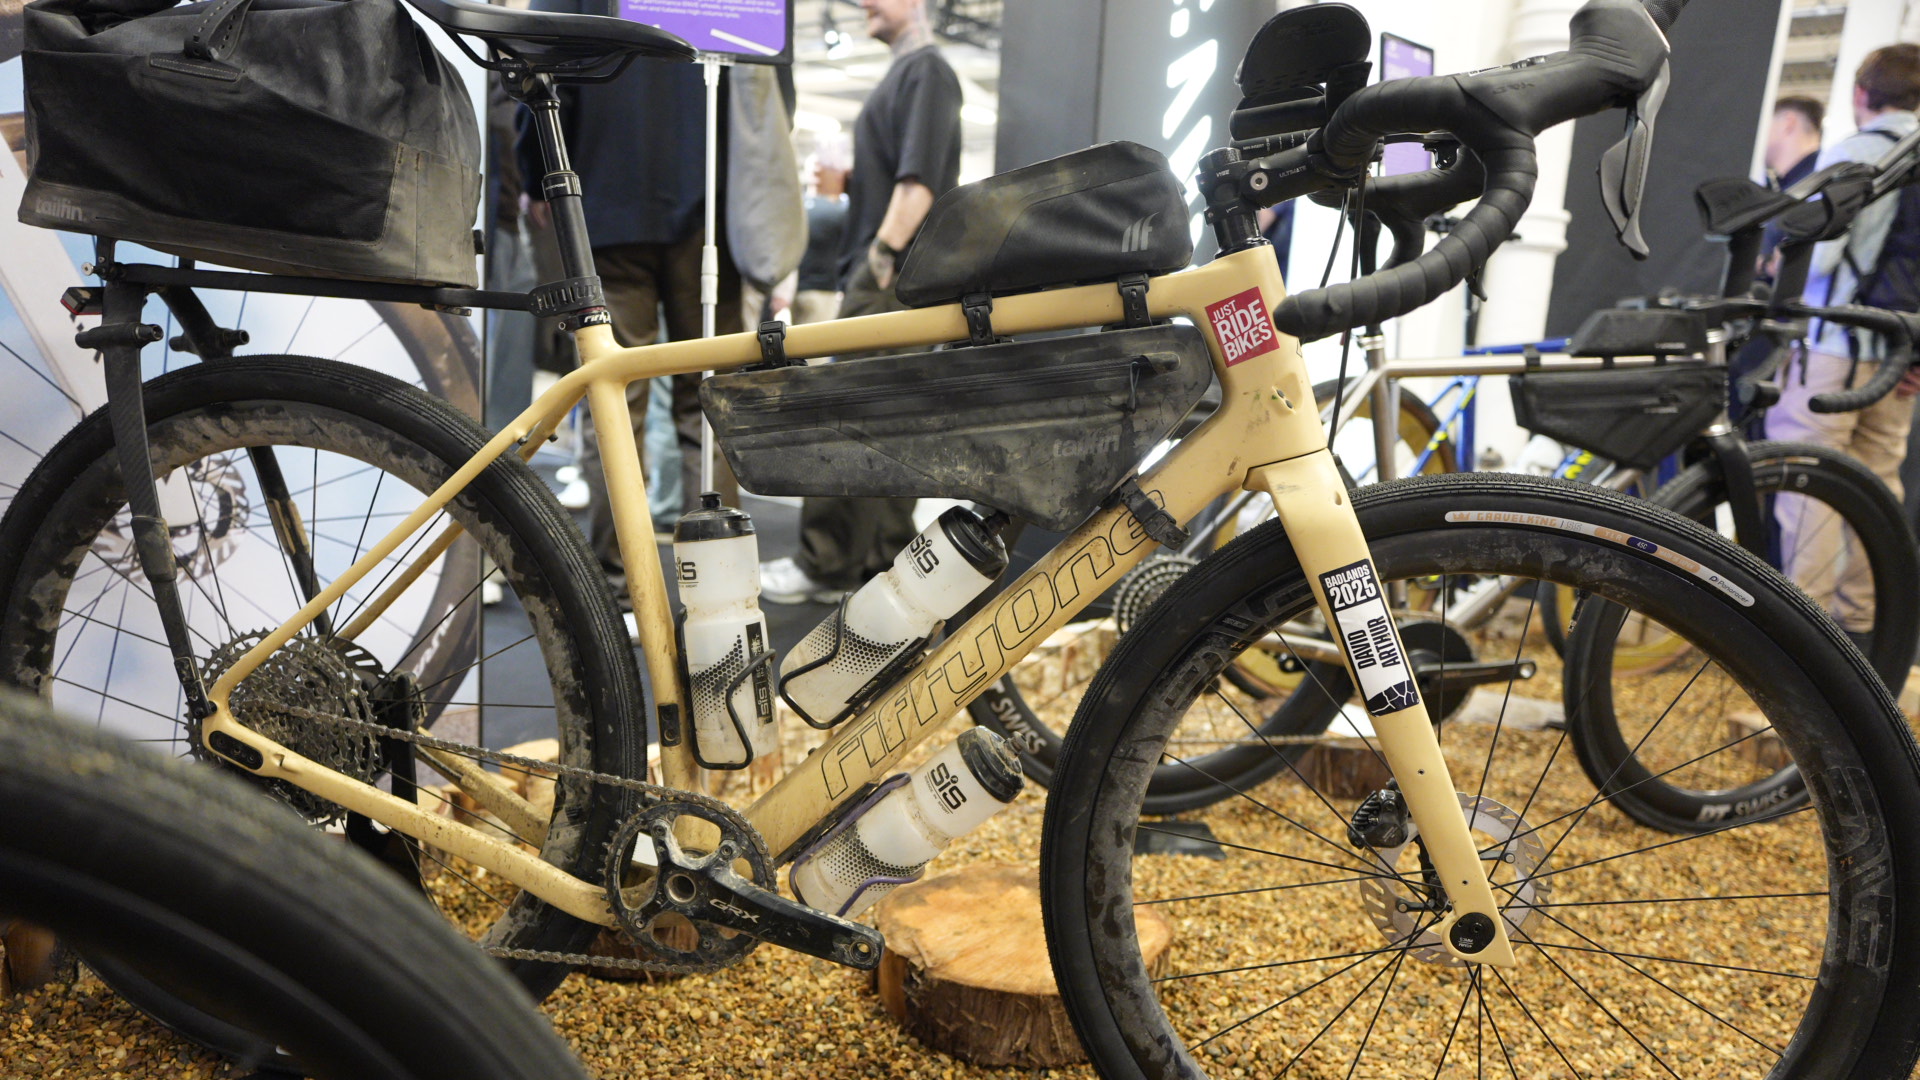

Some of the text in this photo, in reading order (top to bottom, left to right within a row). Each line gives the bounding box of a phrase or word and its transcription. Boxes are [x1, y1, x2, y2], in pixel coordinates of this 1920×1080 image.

[1212, 300, 1237, 324] JUST
[1216, 299, 1266, 345] RIDE
[1224, 321, 1272, 362] BIKES
[1477, 511, 1557, 527] GRAVELKING
[1637, 541, 1648, 550] 45C
[1324, 564, 1370, 589] BADLANDS
[1329, 575, 1377, 609] 2025
[1347, 629, 1377, 670] DAVID
[1366, 615, 1401, 668] ARTHUR
[709, 898, 760, 924] GRX
